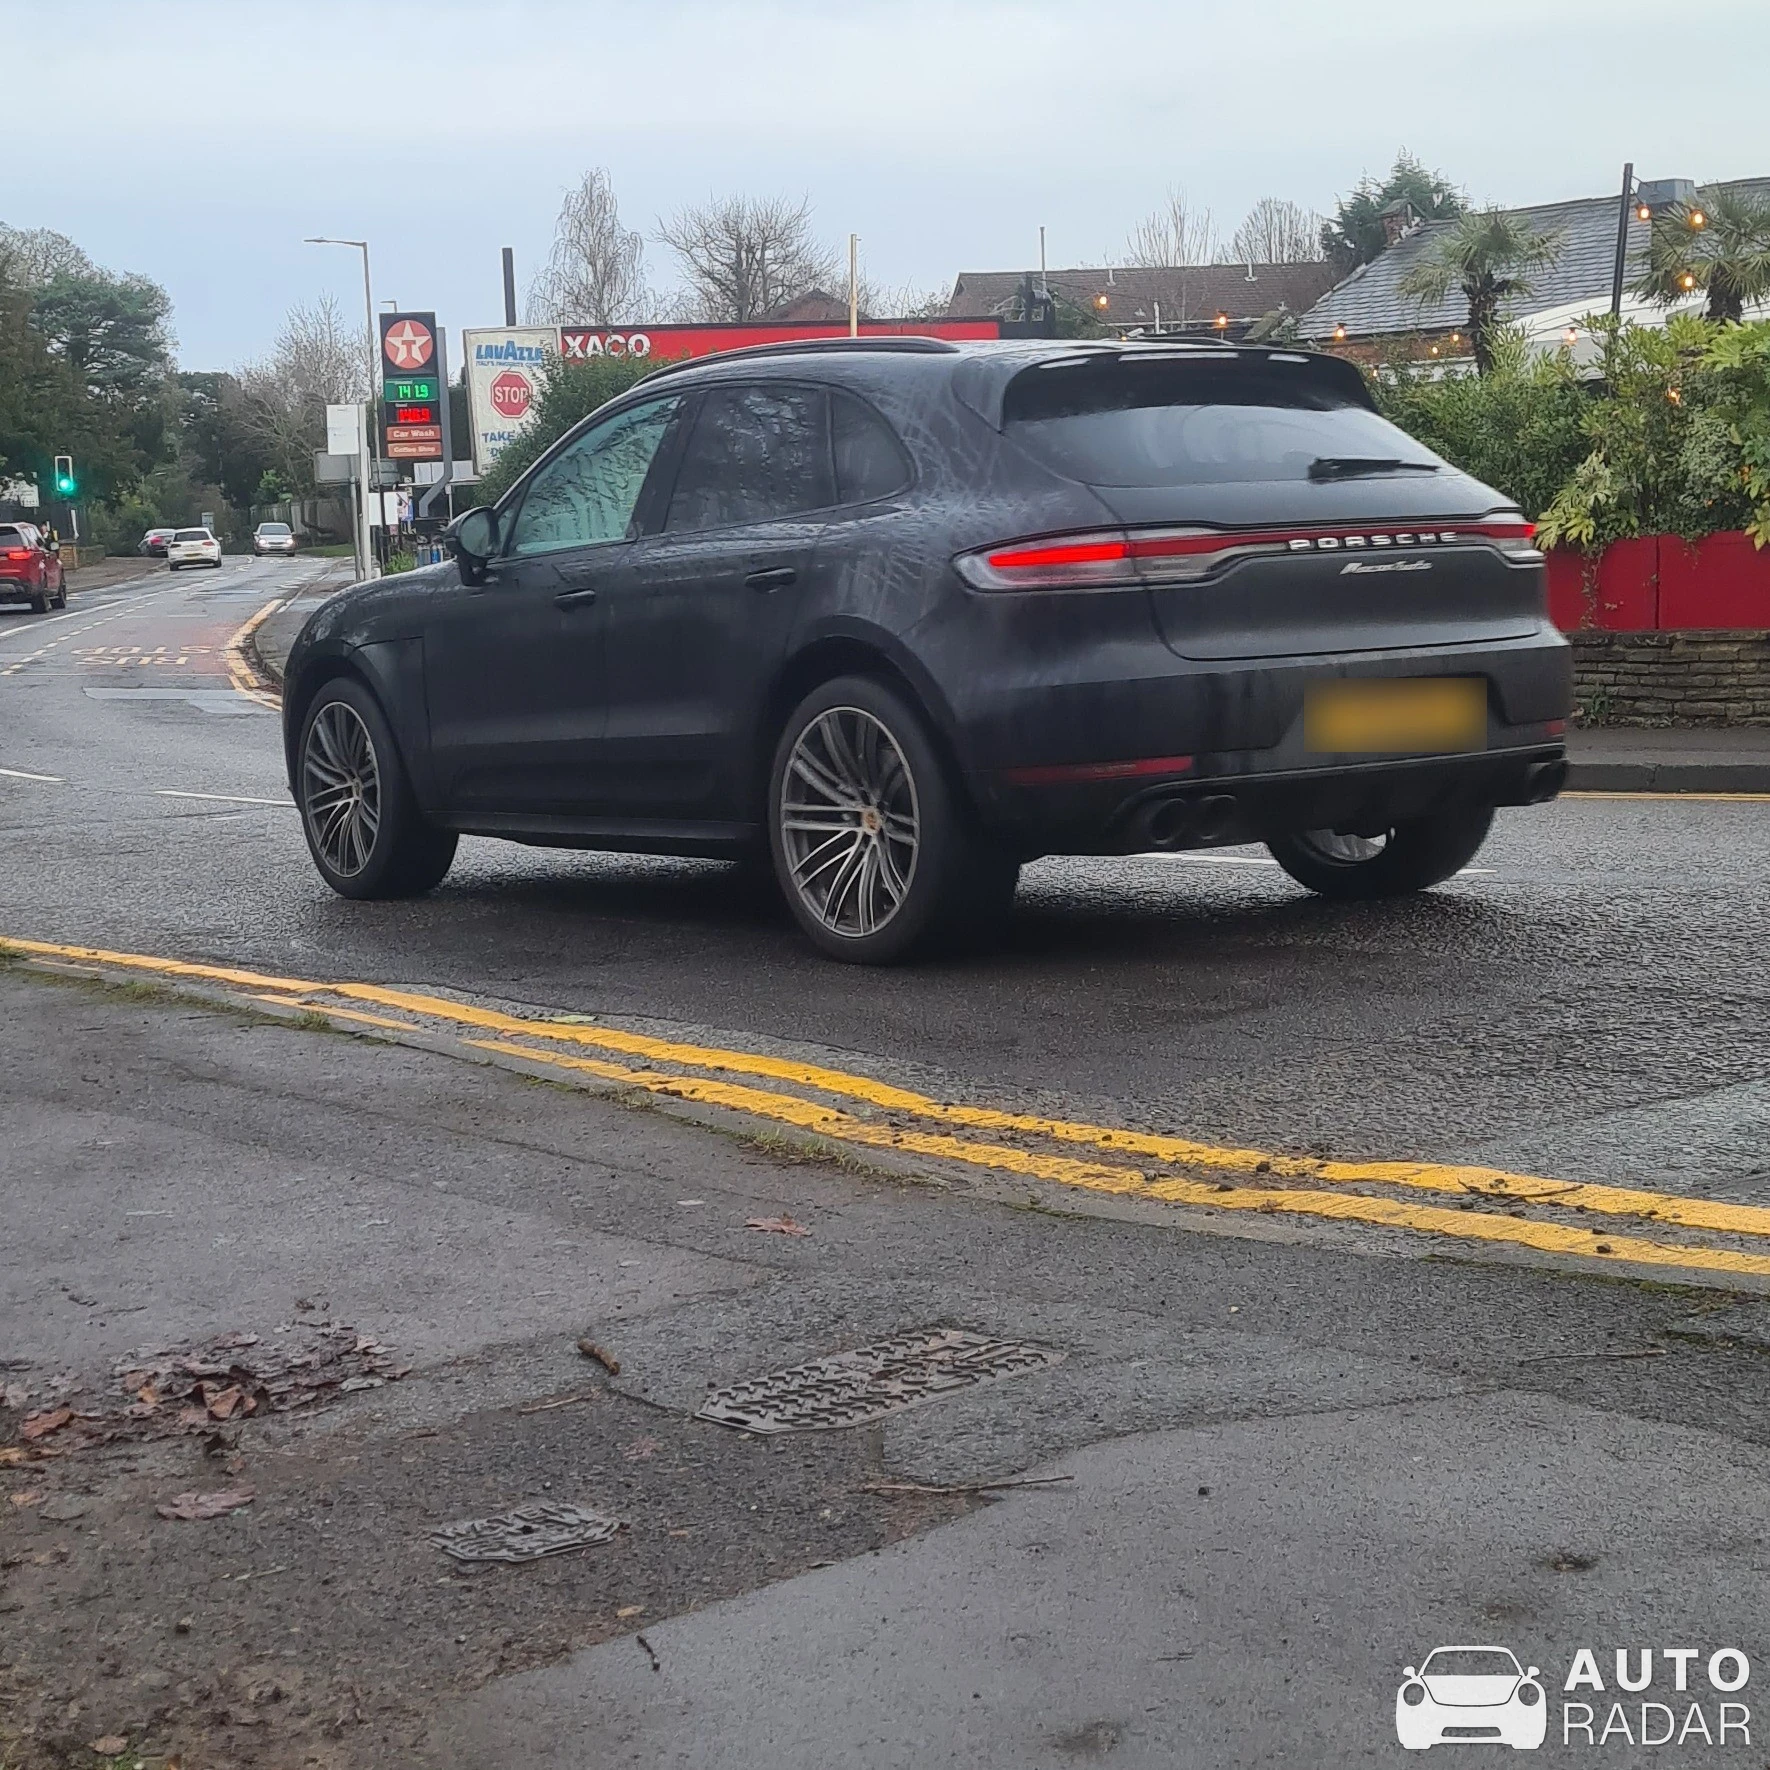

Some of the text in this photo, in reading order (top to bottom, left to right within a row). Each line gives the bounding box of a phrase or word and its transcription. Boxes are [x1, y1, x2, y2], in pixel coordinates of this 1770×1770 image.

[494, 386, 527, 404] STOP
[393, 429, 435, 438] Car Wash
[481, 430, 516, 443] TAKE
[1288, 531, 1458, 550] PORSCHE
